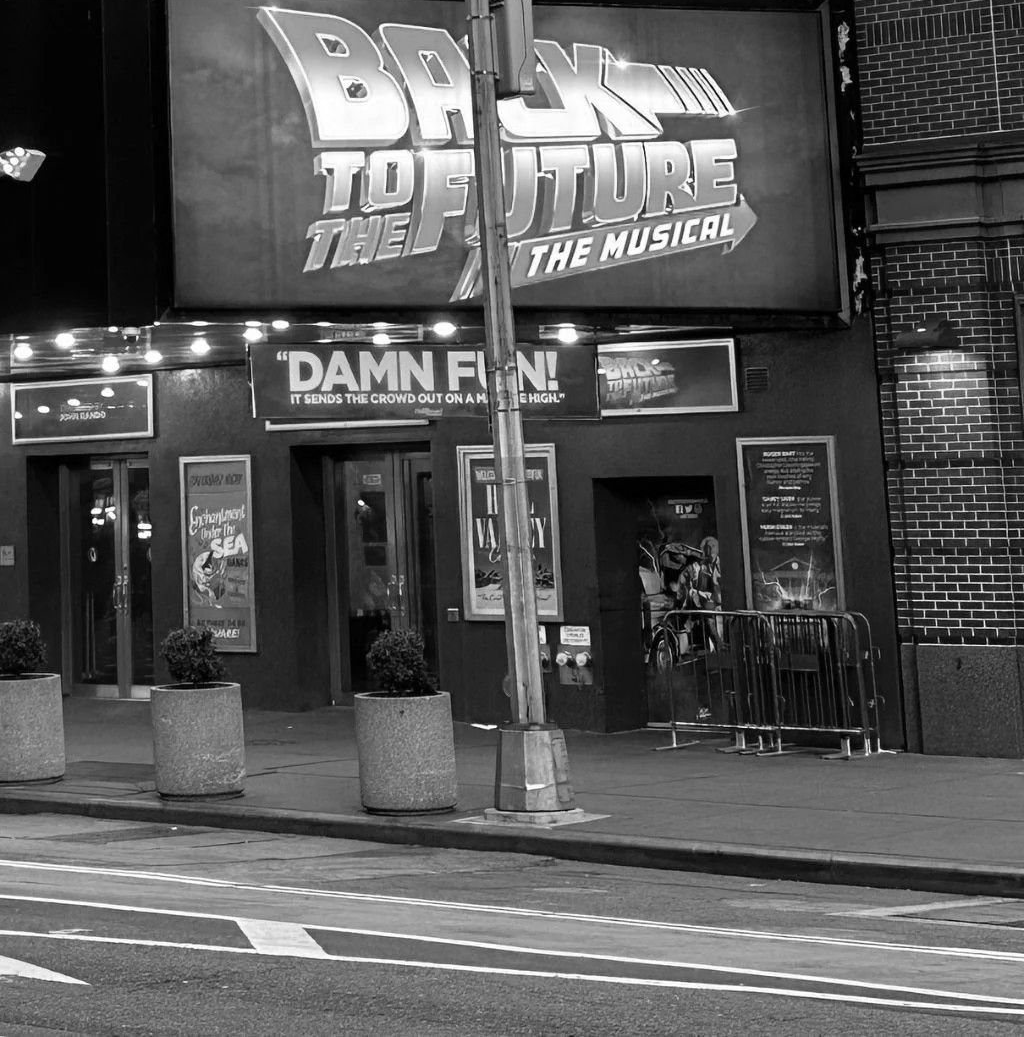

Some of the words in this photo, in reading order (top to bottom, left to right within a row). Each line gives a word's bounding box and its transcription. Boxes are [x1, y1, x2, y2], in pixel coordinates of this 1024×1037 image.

[314, 150, 414, 214] TO
[406, 138, 738, 254] FUTURE
[304, 213, 412, 272] THE
[527, 236, 593, 278] THE
[600, 212, 735, 262] MUSICAL
[276, 350, 435, 392] “DAMN
[290, 393, 303, 404] IT
[304, 393, 343, 404] SENDS
[345, 393, 369, 404] THE
[370, 393, 416, 405] CROWD
[418, 393, 444, 404] OUT
[445, 393, 464, 404] ON
[465, 393, 475, 404] A
[210, 532, 249, 559] SEA
